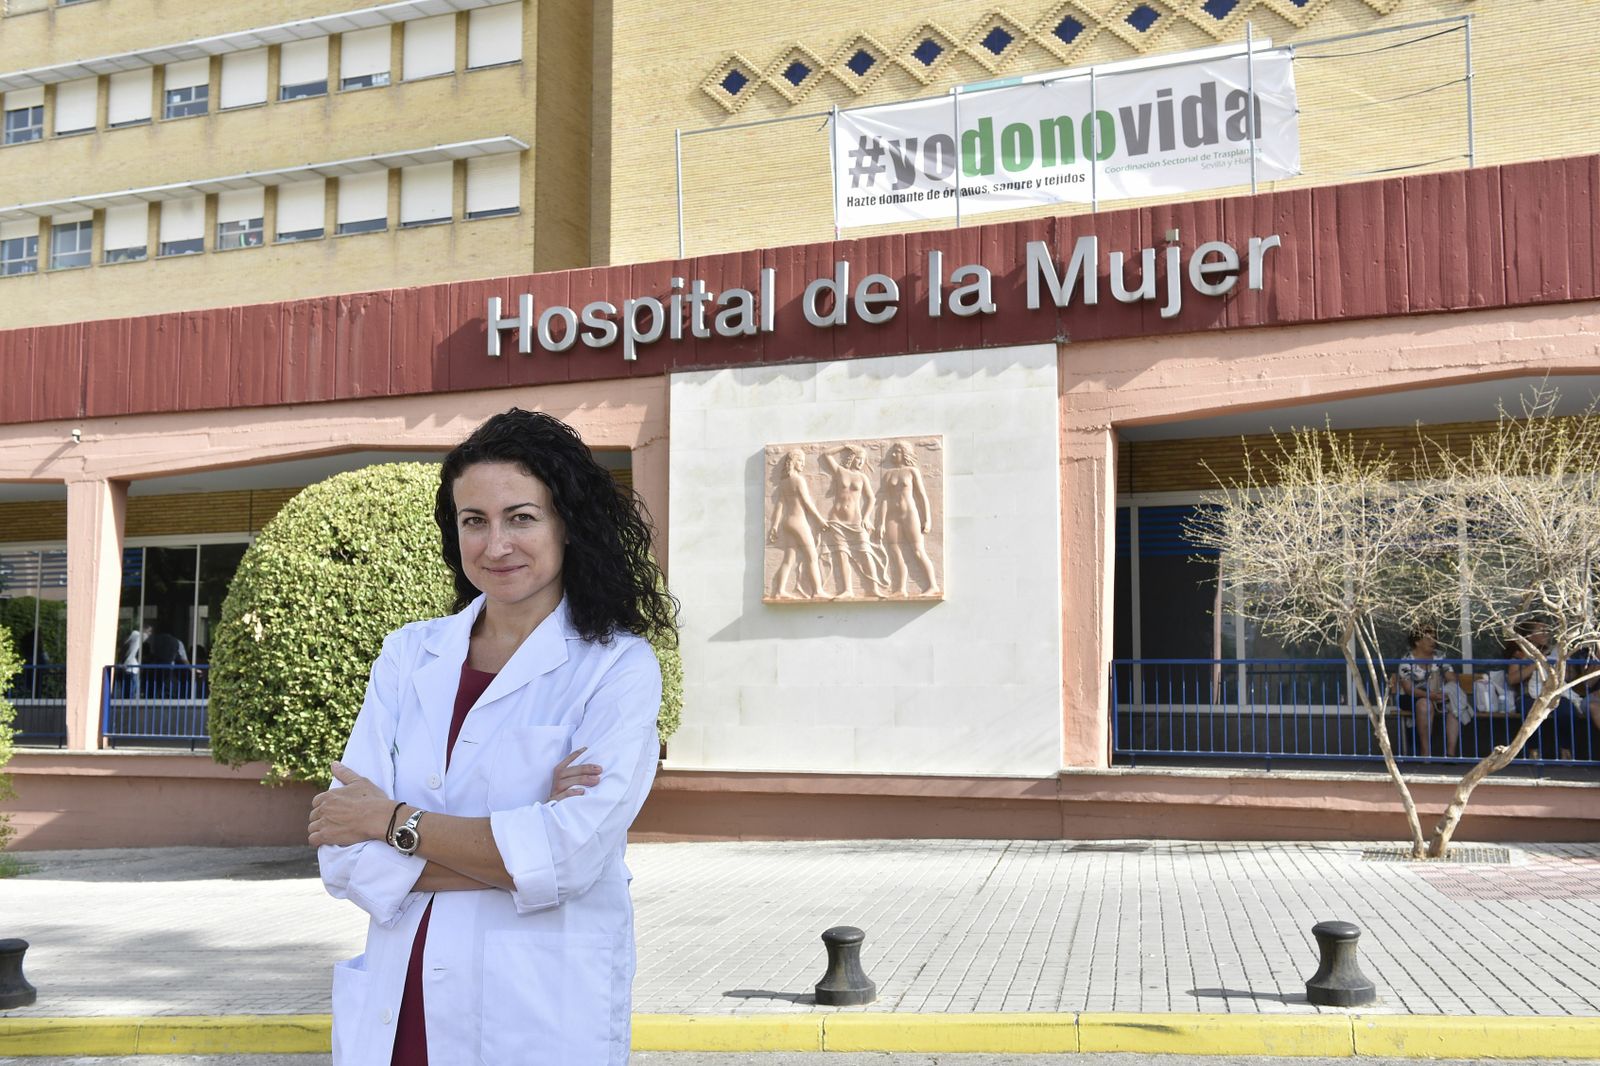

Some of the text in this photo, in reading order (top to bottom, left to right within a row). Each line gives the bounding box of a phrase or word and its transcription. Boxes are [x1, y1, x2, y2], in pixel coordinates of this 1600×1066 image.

[848, 81, 1261, 191] #yodonovida
[1104, 160, 1161, 174] Coordinación
[1162, 154, 1199, 167] Sectorial
[1200, 152, 1211, 161] de
[847, 173, 1086, 207] Hazte donante de óranos, sangre y tejidos
[487, 228, 1282, 360] Hospital de la Mujer
